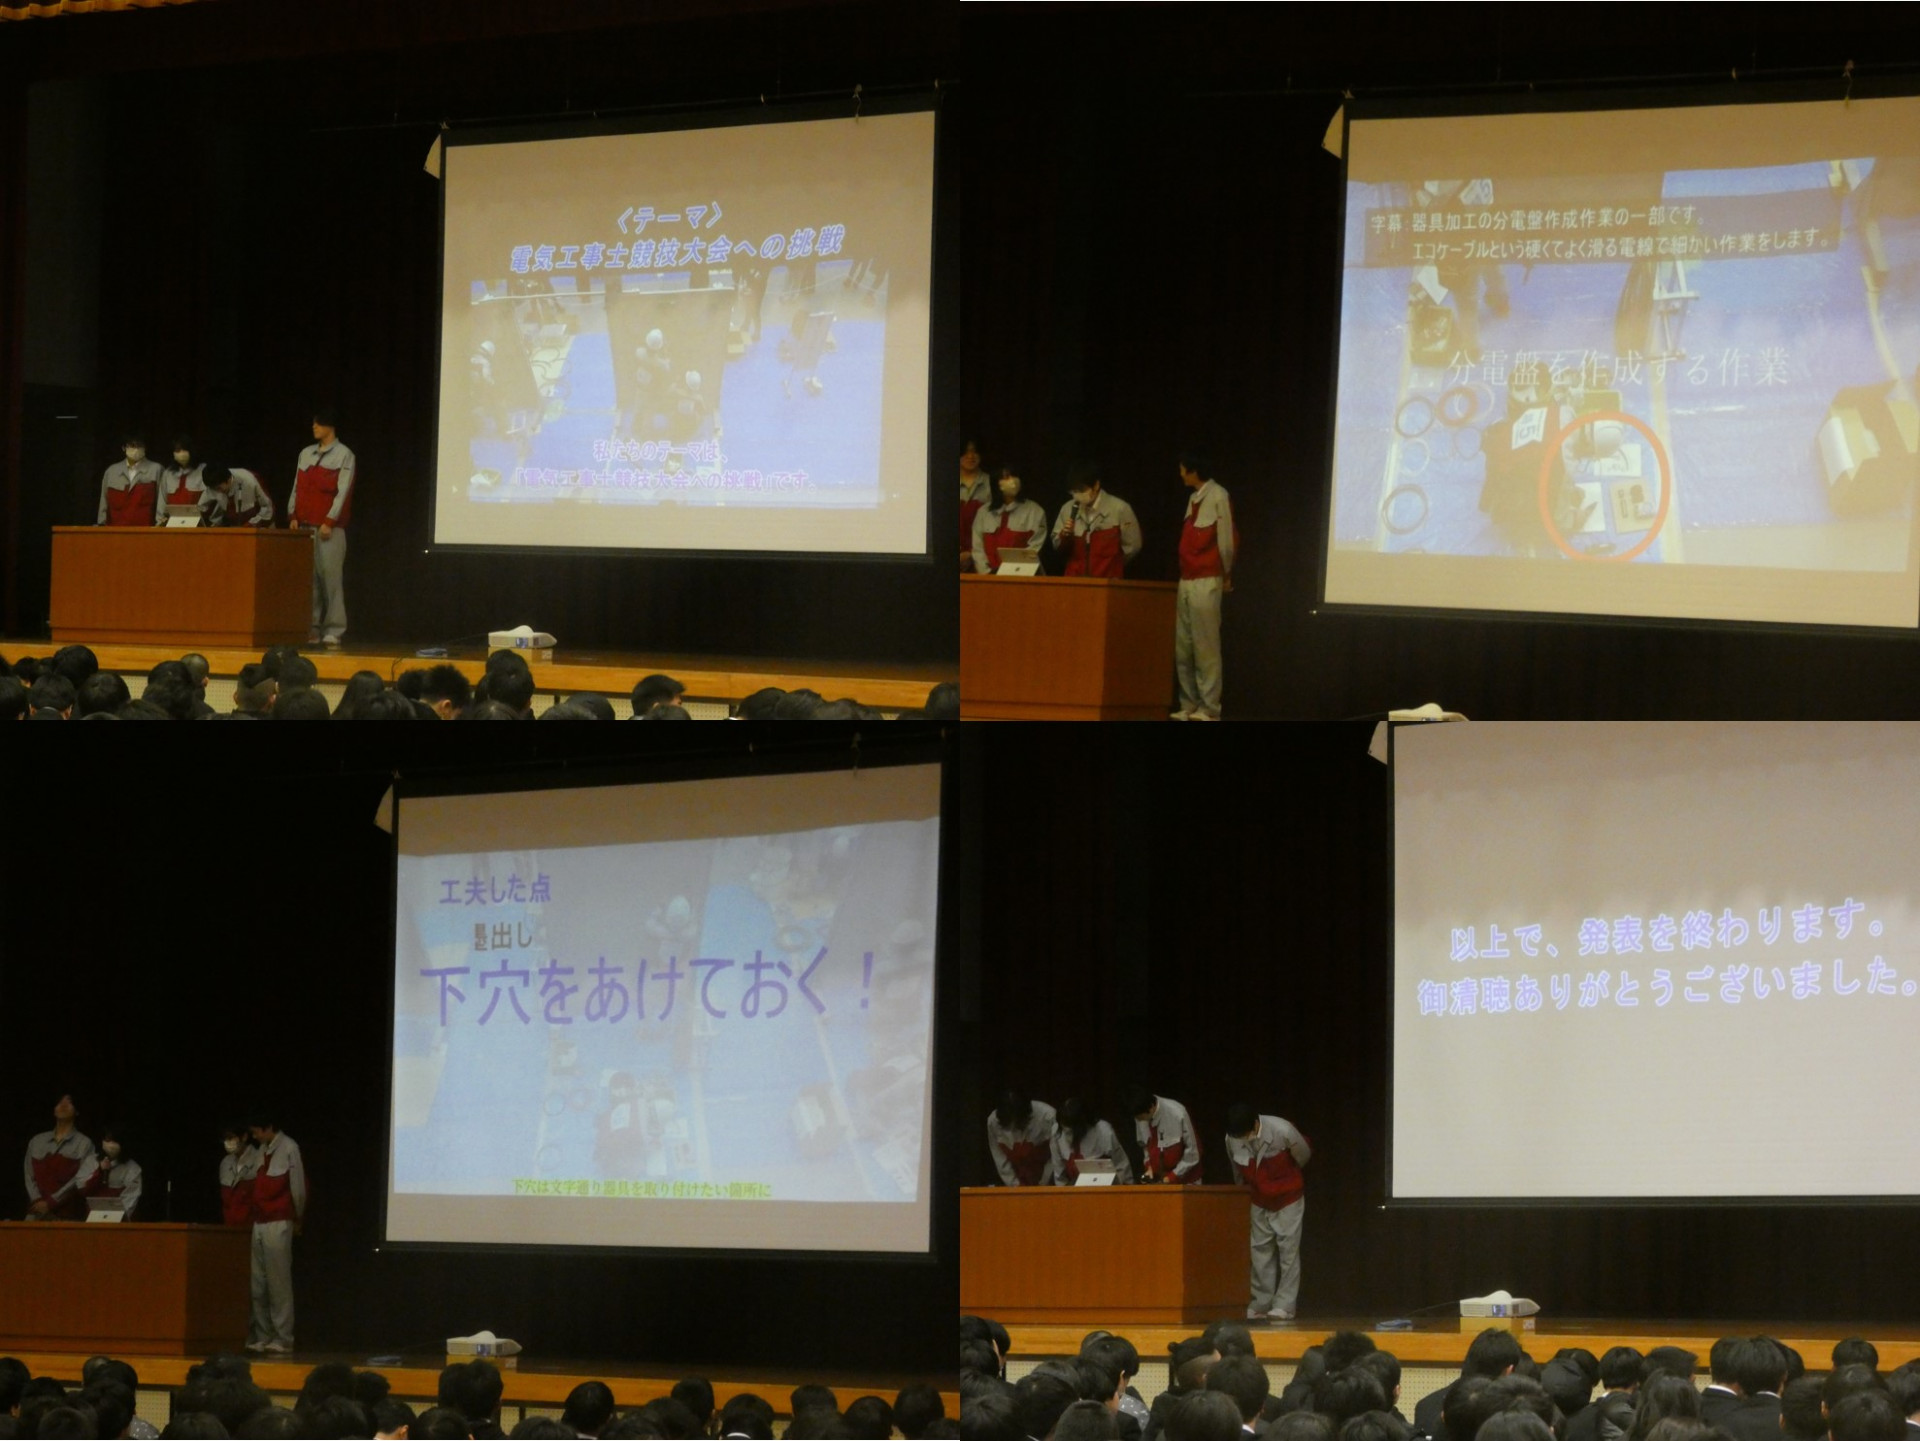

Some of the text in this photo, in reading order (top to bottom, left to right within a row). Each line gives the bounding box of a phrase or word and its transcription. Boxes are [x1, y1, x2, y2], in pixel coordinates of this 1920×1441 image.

[509, 224, 846, 274] 電気工事士競技大会への挑戦
[1448, 347, 1790, 388] 分電盤を作成する作業
[439, 872, 552, 906] 工夫した点
[1417, 954, 1918, 1016] 御清聴ありがとうございました。
